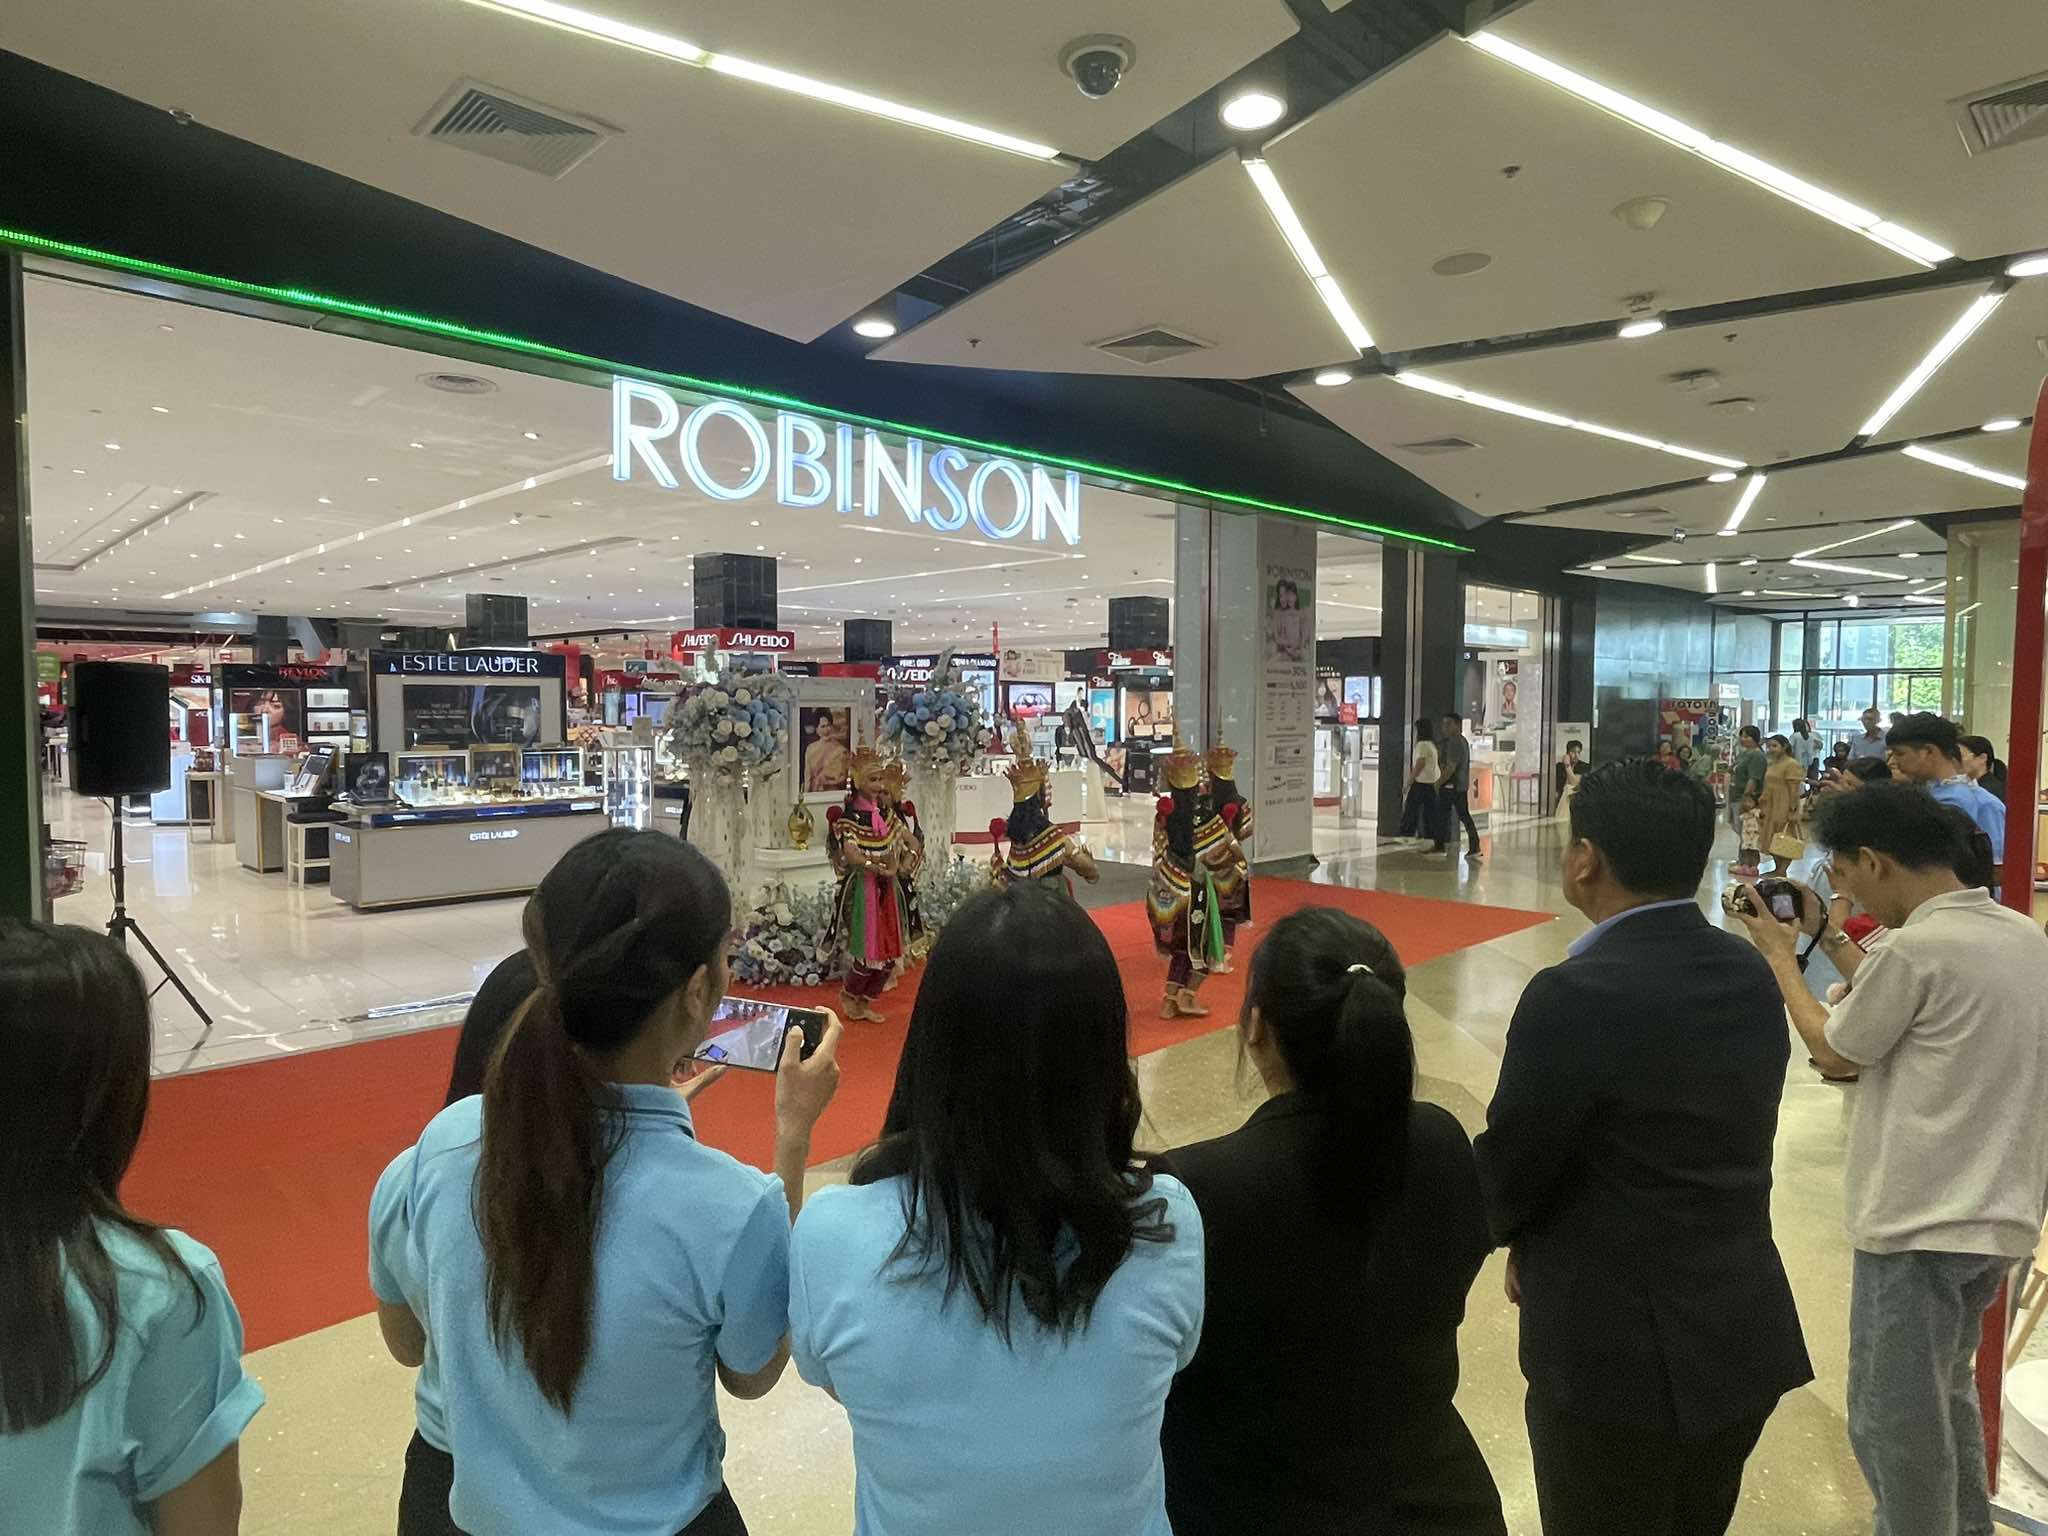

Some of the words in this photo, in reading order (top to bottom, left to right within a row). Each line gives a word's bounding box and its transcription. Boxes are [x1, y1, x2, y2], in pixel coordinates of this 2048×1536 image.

[612, 375, 1080, 546] ROBINSON
[681, 634, 718, 648] SHISEI
[727, 632, 790, 648] SHISEIDO
[278, 667, 328, 678] REVLON
[465, 656, 539, 673] LAUDER
